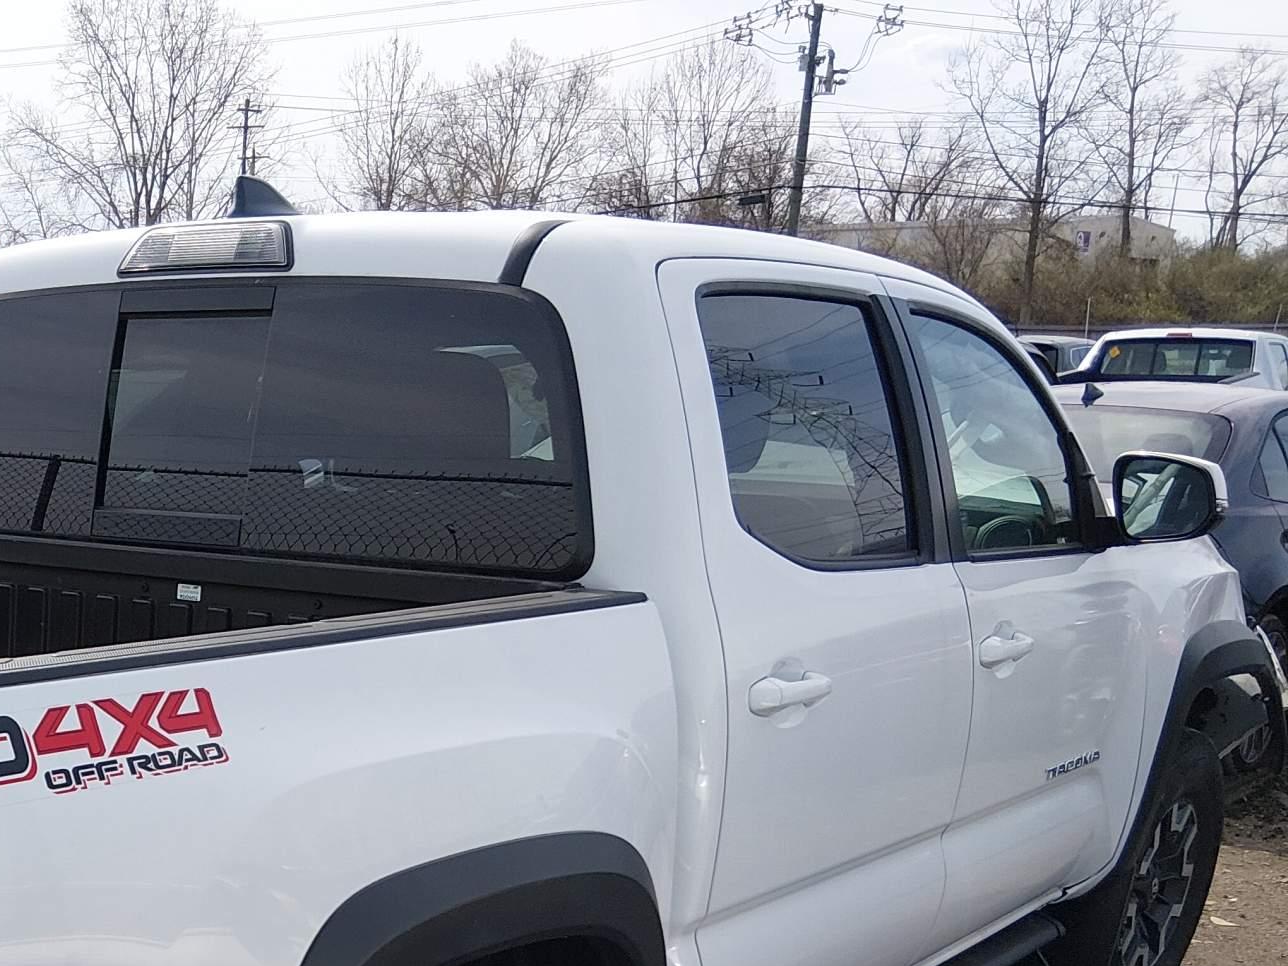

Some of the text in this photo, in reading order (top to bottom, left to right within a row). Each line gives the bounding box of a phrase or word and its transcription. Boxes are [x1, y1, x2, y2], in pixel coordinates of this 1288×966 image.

[44, 742, 230, 795] OFF ROAD
[1046, 750, 1100, 780] TACOMA
